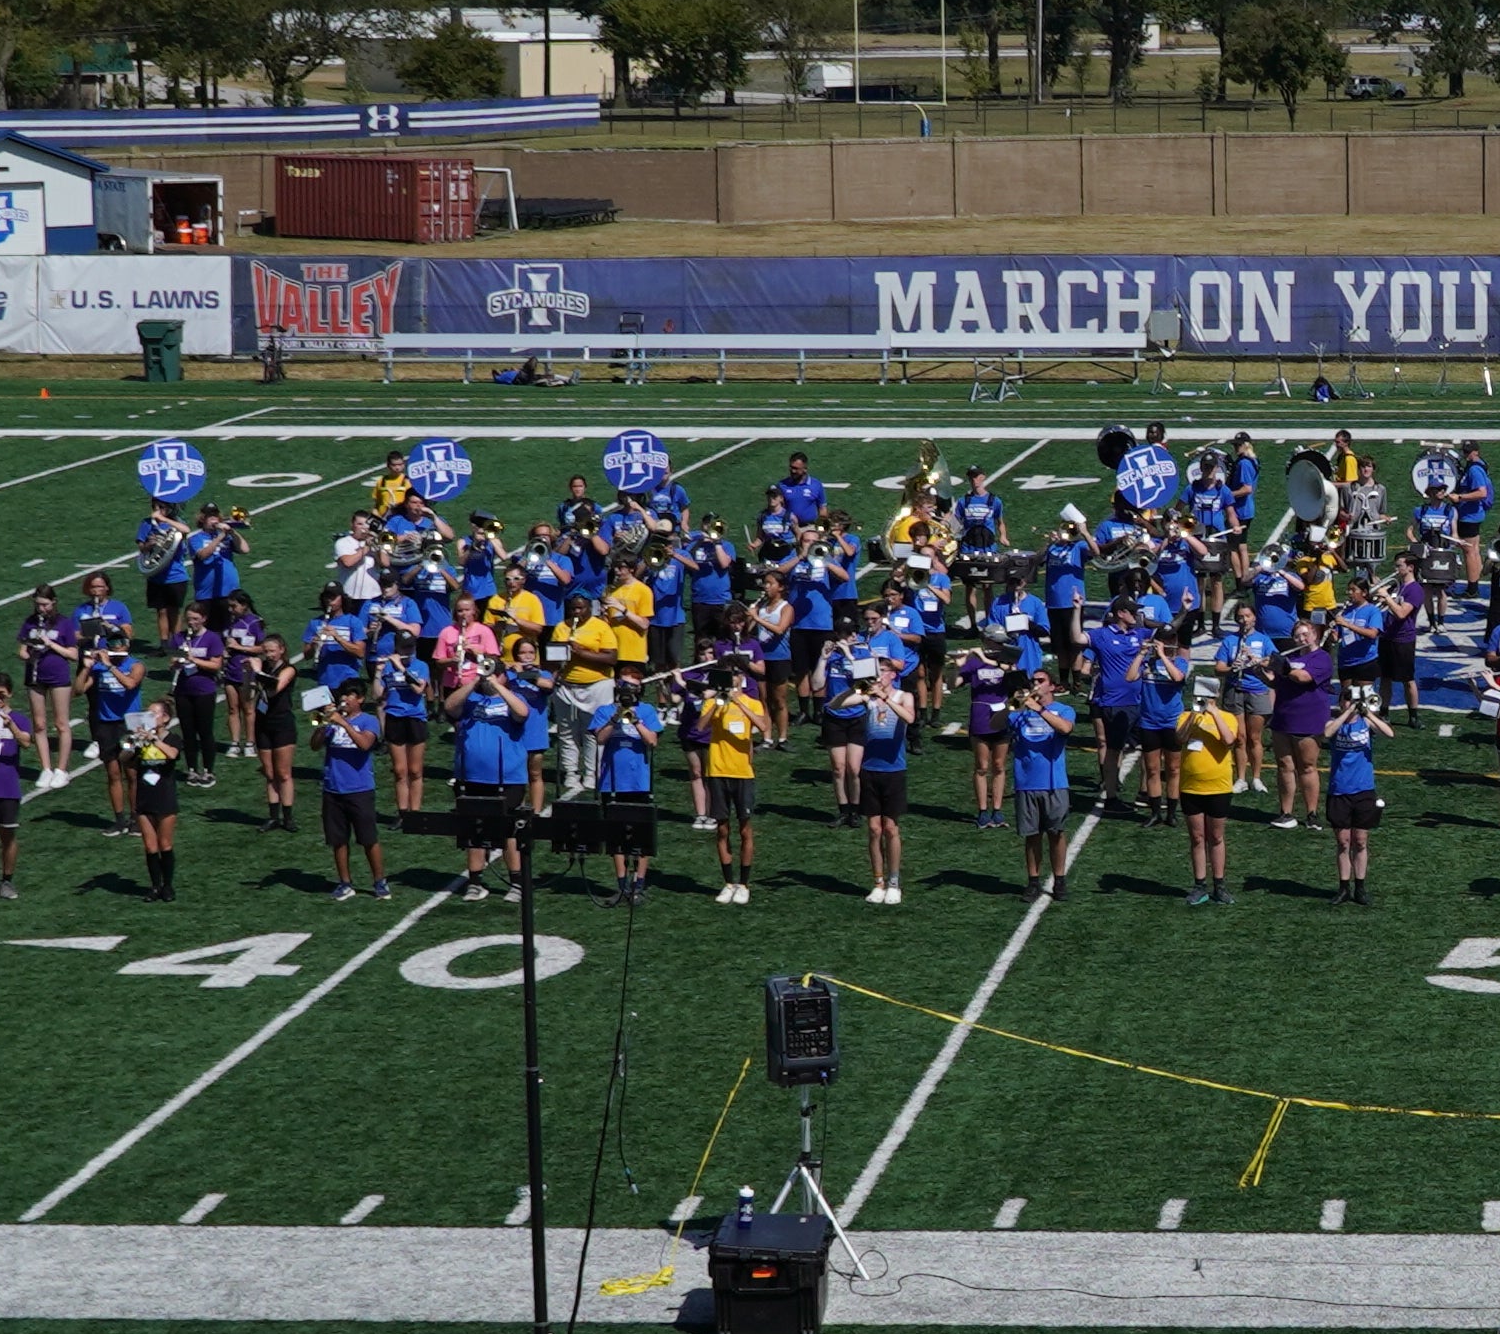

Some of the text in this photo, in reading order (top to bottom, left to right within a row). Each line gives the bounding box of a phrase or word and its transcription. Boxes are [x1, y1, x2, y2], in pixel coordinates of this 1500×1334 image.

[300, 263, 349, 282] THE
[71, 290, 220, 309] U.S. LAWNS
[251, 259, 404, 337] VALLEY
[491, 292, 587, 313] SYCAMORES
[874, 270, 1157, 335] MARCH
[1189, 270, 1296, 343] ON
[1333, 270, 1493, 343] YOU
[140, 460, 204, 474] SYCAMORES
[408, 459, 472, 475] SYCAMORES
[606, 453, 668, 468] SYCAMORES
[1118, 460, 1176, 487] SYCAMORES
[117, 932, 586, 989] 40
